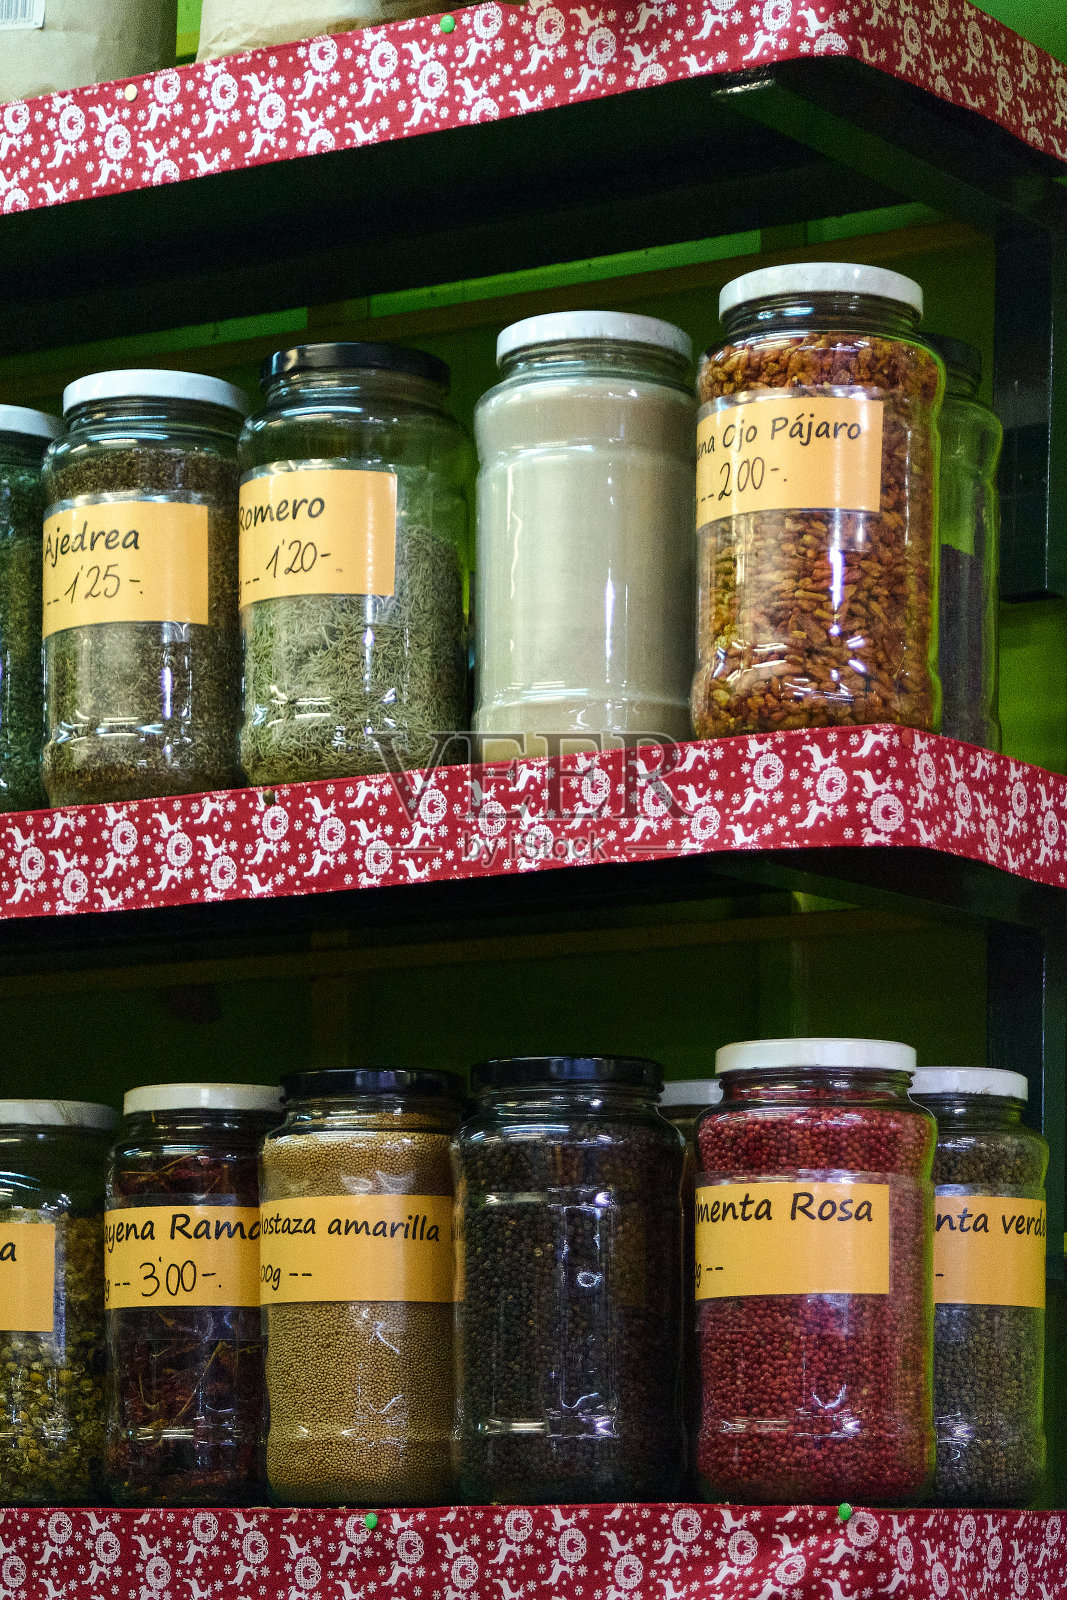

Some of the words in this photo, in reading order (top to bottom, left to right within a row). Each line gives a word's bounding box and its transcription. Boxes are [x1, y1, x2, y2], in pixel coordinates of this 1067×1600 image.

[770, 413, 862, 446] Pájaro
[44, 521, 140, 568] Ajedrea
[790, 1191, 873, 1222] Rosa
[327, 1214, 440, 1242] amarilla
